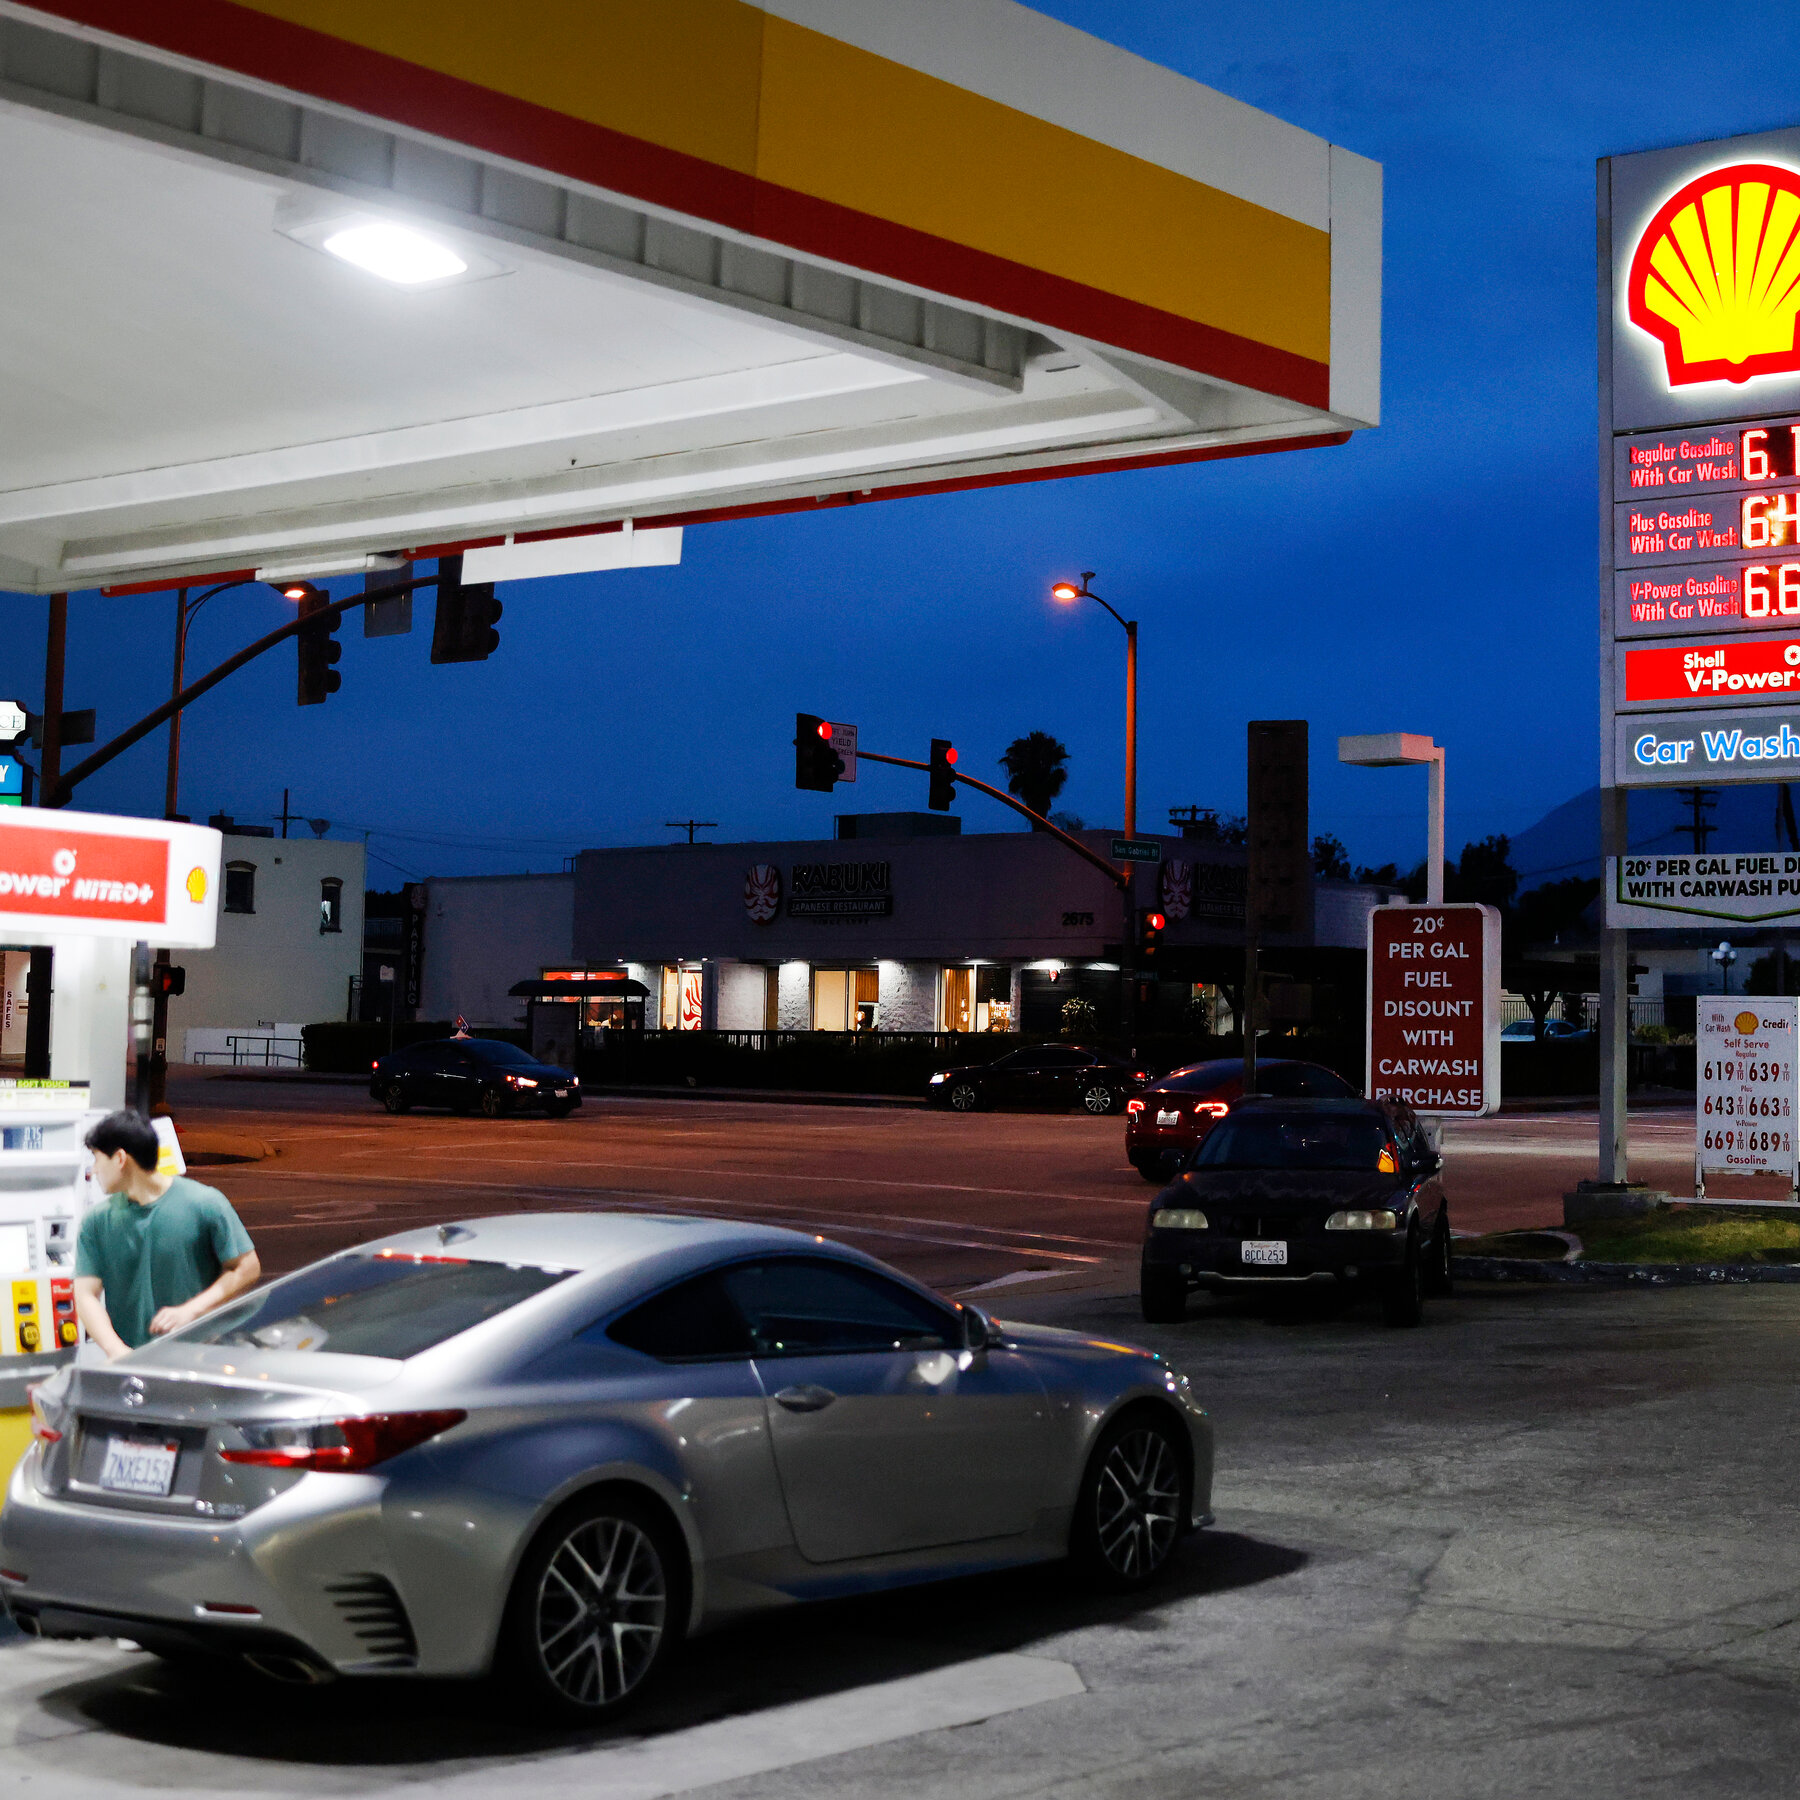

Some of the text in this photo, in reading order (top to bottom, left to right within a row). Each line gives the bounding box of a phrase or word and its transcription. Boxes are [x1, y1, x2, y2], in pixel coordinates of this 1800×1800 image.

[1630, 437, 1734, 467] Regular Gasoline
[1630, 460, 1738, 487] With Car Wash
[1630, 508, 1712, 532] Plus Gasoline
[1630, 526, 1738, 553] With Car Wash
[1630, 575, 1738, 600] V-Power Gasoline
[1631, 596, 1739, 622] With Car Wash
[1683, 650, 1725, 669] Shell
[1684, 669, 1795, 692] V-Power
[1634, 725, 1800, 766] Car Wash
[1656, 859, 1690, 877] PER
[1695, 858, 1731, 876] GAL
[1735, 857, 1780, 875] FUEL
[791, 861, 890, 894] KABUKI
[1628, 880, 1675, 899] WITH
[1680, 879, 1773, 898] CARWASH
[791, 900, 887, 913] JAPANESE RESTAURANT
[1062, 911, 1094, 926] 2675
[407, 913, 419, 1005] PARKING
[1388, 942, 1470, 959] PER GAL
[1404, 972, 1453, 988] FUEL
[5, 991, 13, 1029] SAFES
[1384, 1001, 1474, 1017] DISOUNT
[1402, 1030, 1454, 1046] WITH
[1705, 1023, 1731, 1034] Car Wash
[1724, 1039, 1770, 1050] Self Serve
[1735, 1050, 1757, 1060] Regular
[1379, 1059, 1478, 1076] CARWASH
[1704, 1061, 1734, 1081] 619
[1749, 1062, 1780, 1082] 639
[1704, 1096, 1734, 1116] 643
[1749, 1097, 1780, 1117] 663
[1704, 1130, 1734, 1150] 669
[1749, 1132, 1780, 1152] 689
[1726, 1154, 1767, 1166] Gasoline
